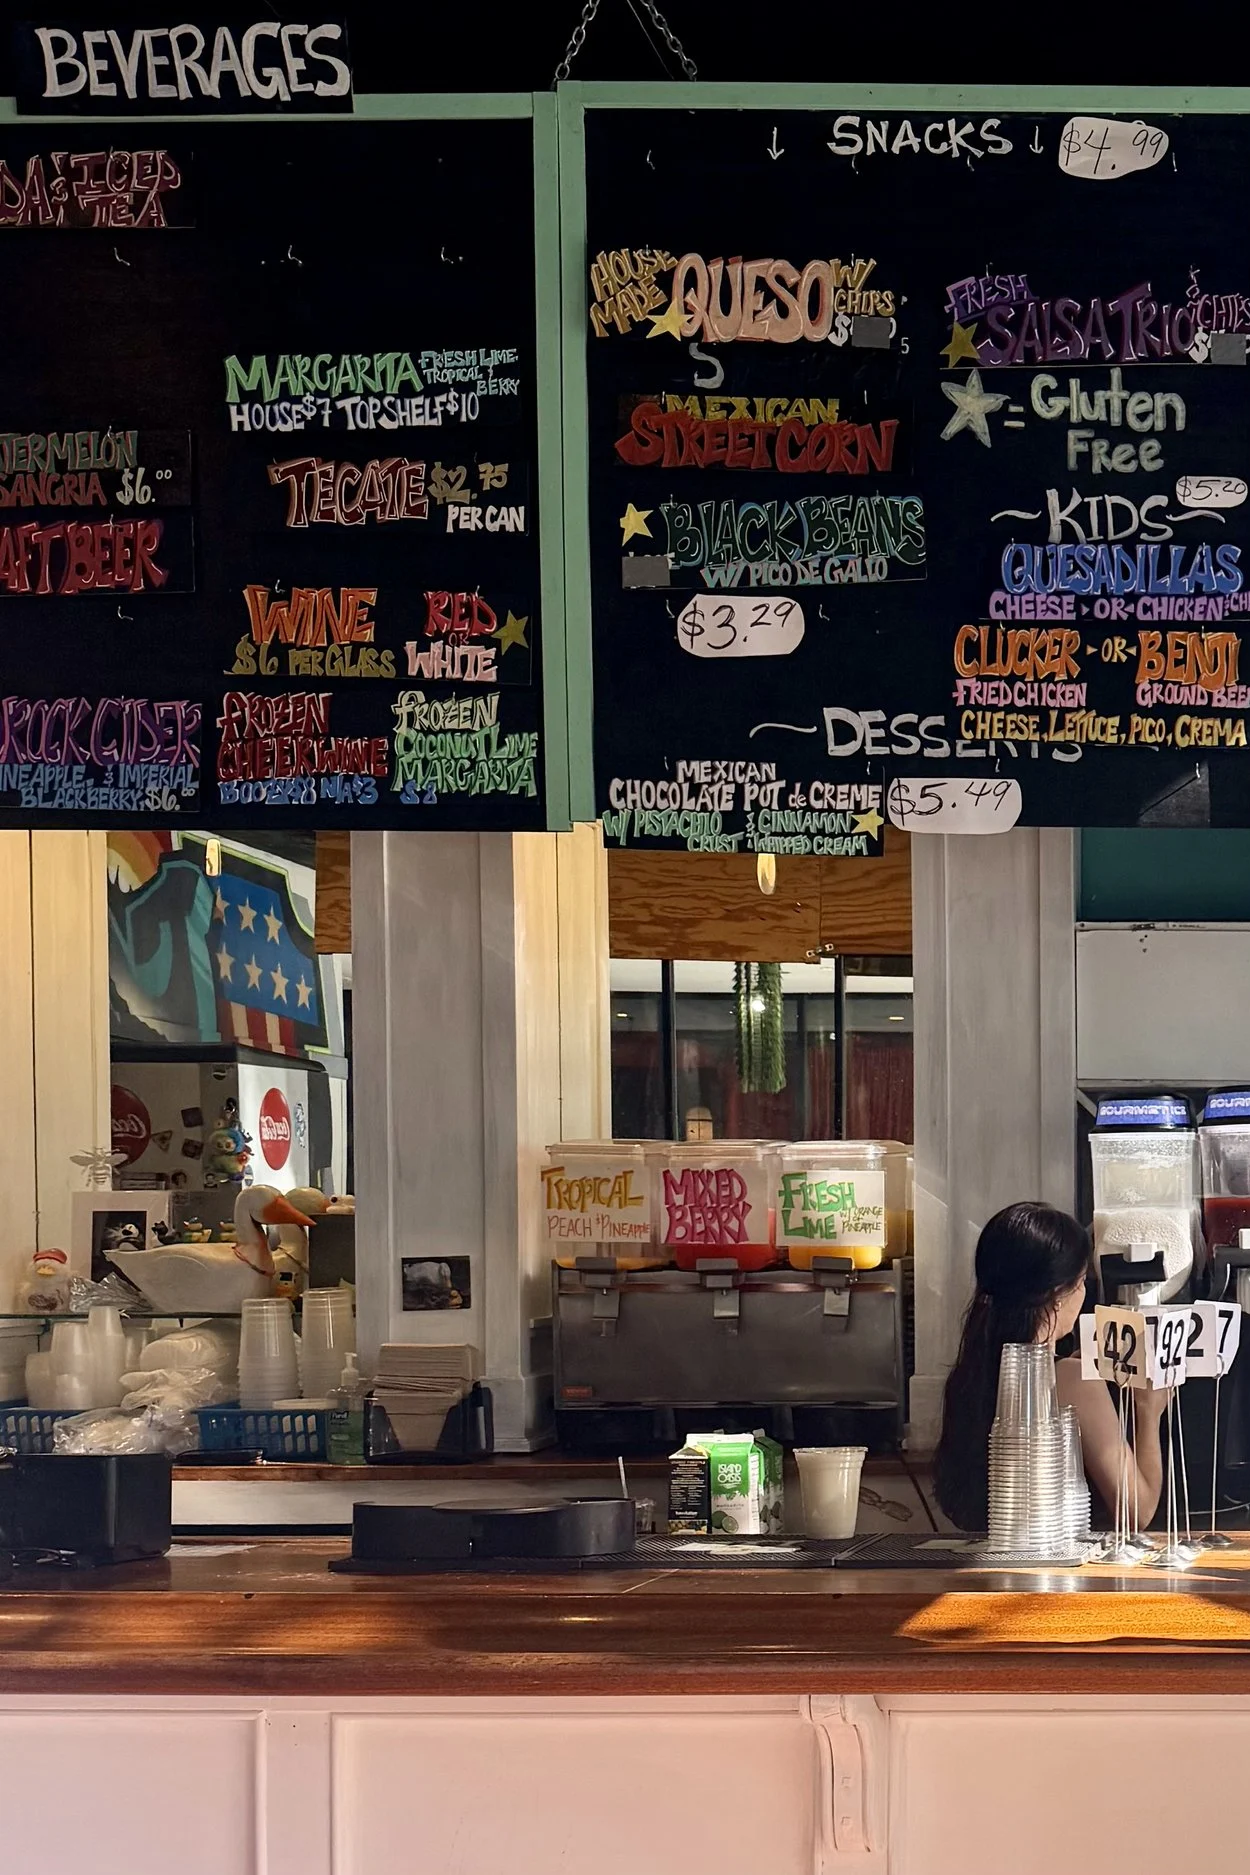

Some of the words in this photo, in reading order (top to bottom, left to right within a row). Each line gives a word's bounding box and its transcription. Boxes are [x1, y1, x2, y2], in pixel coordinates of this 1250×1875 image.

[35, 22, 352, 101] BEVERAGES
[827, 116, 1013, 157] SNACKS
[1063, 122, 1164, 174] $4.99
[591, 248, 678, 302] HOUSE
[671, 252, 834, 342] QUESO
[590, 273, 668, 337] MADE
[224, 352, 424, 403] MARGARITA
[424, 367, 482, 384] TROPICAL
[477, 378, 520, 396] BERRY
[665, 394, 839, 426] MEXICAN
[1031, 367, 1186, 432] Gluten
[614, 402, 776, 468] STREET
[775, 419, 899, 474] CORN
[0, 472, 108, 507] SANGRIA
[116, 467, 172, 505] $6.00
[268, 457, 429, 527] TECATE
[427, 460, 509, 504] $2.75
[446, 504, 483, 532] PER
[485, 505, 525, 531] CAN
[660, 499, 800, 568] BLACK
[795, 495, 926, 565] BEANS
[1046, 487, 1174, 544] KIDS
[60, 520, 170, 594] BEER
[750, 559, 792, 585] PICO
[1001, 543, 1244, 594] QUESADILLAS
[243, 585, 378, 646] WINE
[424, 591, 497, 636] RED
[681, 600, 796, 649] $3.29
[988, 591, 1077, 621] CHEESE
[1136, 594, 1224, 621] CHICKEN
[231, 633, 278, 675] $6
[324, 645, 396, 678] GLASS
[404, 640, 497, 682] WHITE
[953, 624, 1081, 680] CLUCKER
[1135, 629, 1242, 692] BENJI
[90, 697, 202, 768] CIDER
[216, 691, 333, 742] FROZEN
[391, 691, 500, 735] FROZEN
[1174, 713, 1248, 747] CREMA
[119, 764, 199, 789] IMPERIAL
[217, 736, 389, 780] CHEERWINE
[390, 755, 538, 796] MARGARITA
[676, 760, 776, 783] MEXICAN
[609, 778, 735, 811] CHOCOLATE
[743, 780, 785, 812] POT
[809, 781, 883, 808] CREME
[888, 778, 1012, 827] $5.49
[634, 810, 722, 838] PISTACHIO
[758, 809, 850, 835] CINNAMON
[687, 832, 744, 853] CRUST
[813, 834, 868, 855] CREAM
[541, 1166, 644, 1212] TROPICAL
[662, 1168, 748, 1206] MIXED
[779, 1172, 856, 1211] FRESH
[547, 1215, 592, 1238] PEACH
[665, 1204, 752, 1244] BERRY
[781, 1209, 837, 1240] LIME
[1104, 1320, 1137, 1374] 42
[1160, 1319, 1184, 1369] 92
[717, 1473, 742, 1483] OASIS
[718, 1463, 742, 1473] ISLAND
